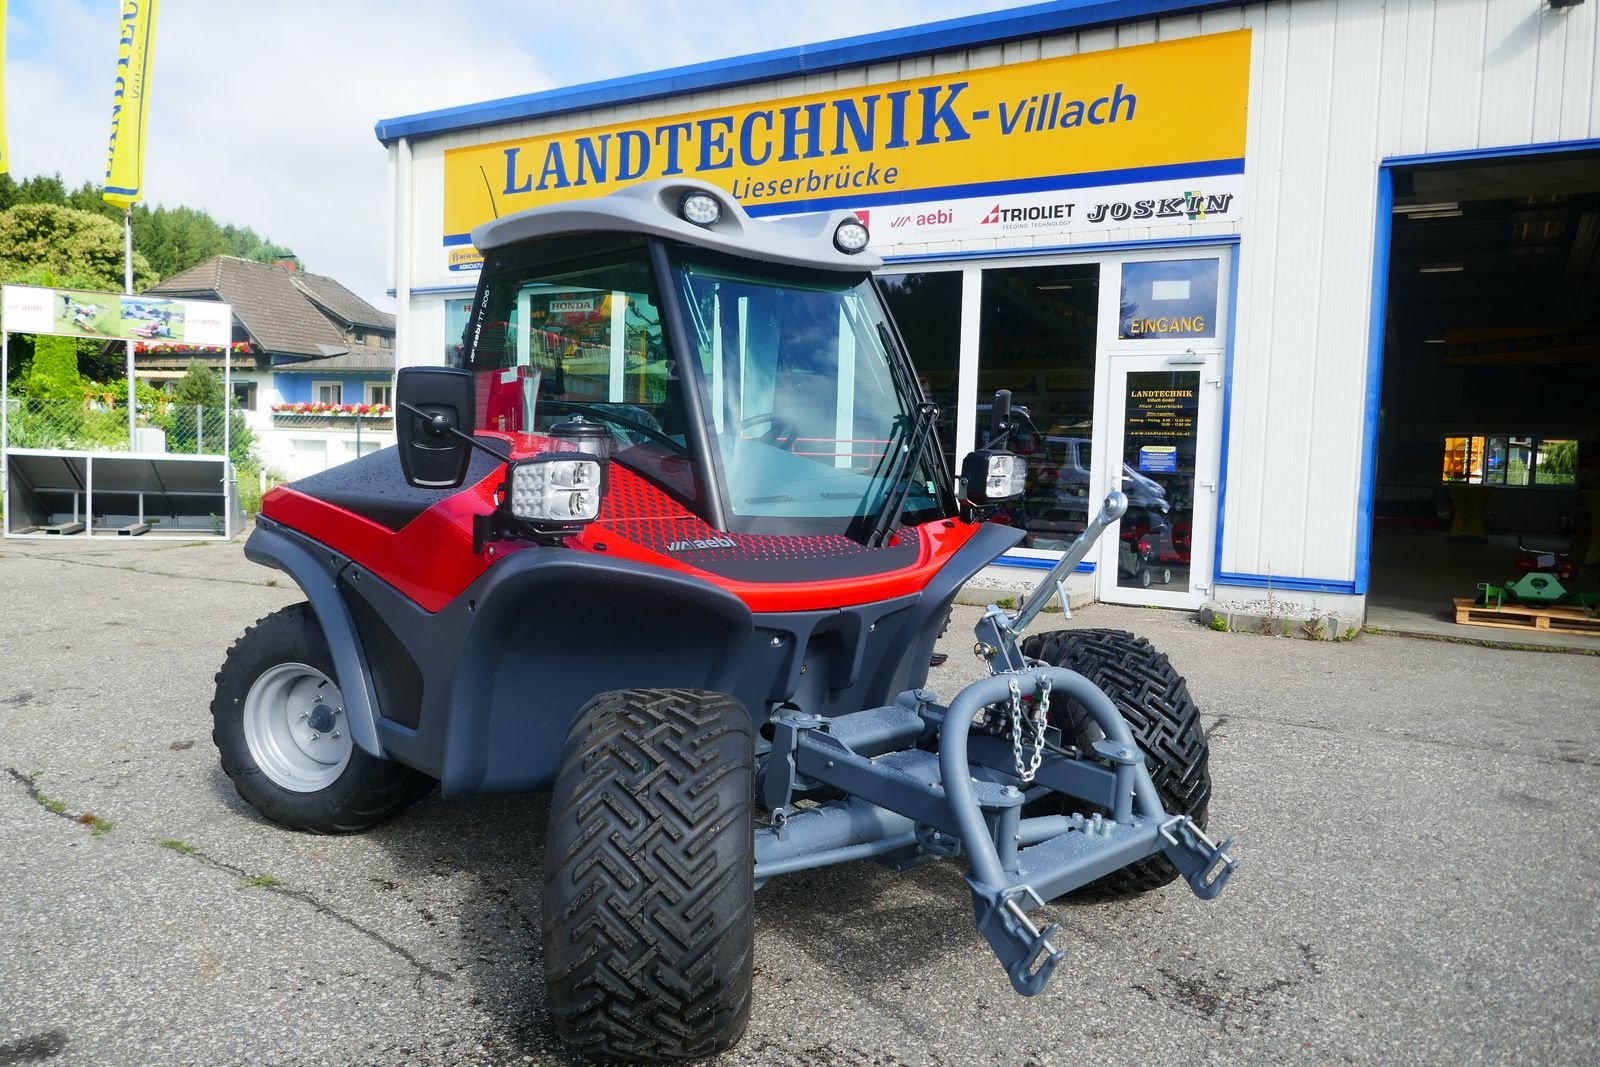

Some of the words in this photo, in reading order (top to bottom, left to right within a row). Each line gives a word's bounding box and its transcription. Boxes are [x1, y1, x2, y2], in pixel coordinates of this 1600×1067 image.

[732, 162, 898, 200] Lieserbrücke
[916, 208, 953, 226] aebi
[1000, 203, 1075, 222] TRIOLIET
[1087, 193, 1234, 223] JOSKIN
[1031, 220, 1072, 229] TECHNOLOGY
[551, 301, 591, 310] HONDA
[1130, 316, 1205, 334] EINGANG
[472, 324, 482, 348] aebi
[1131, 390, 1192, 398] LANDTECHNIK
[693, 535, 738, 549] aebi
